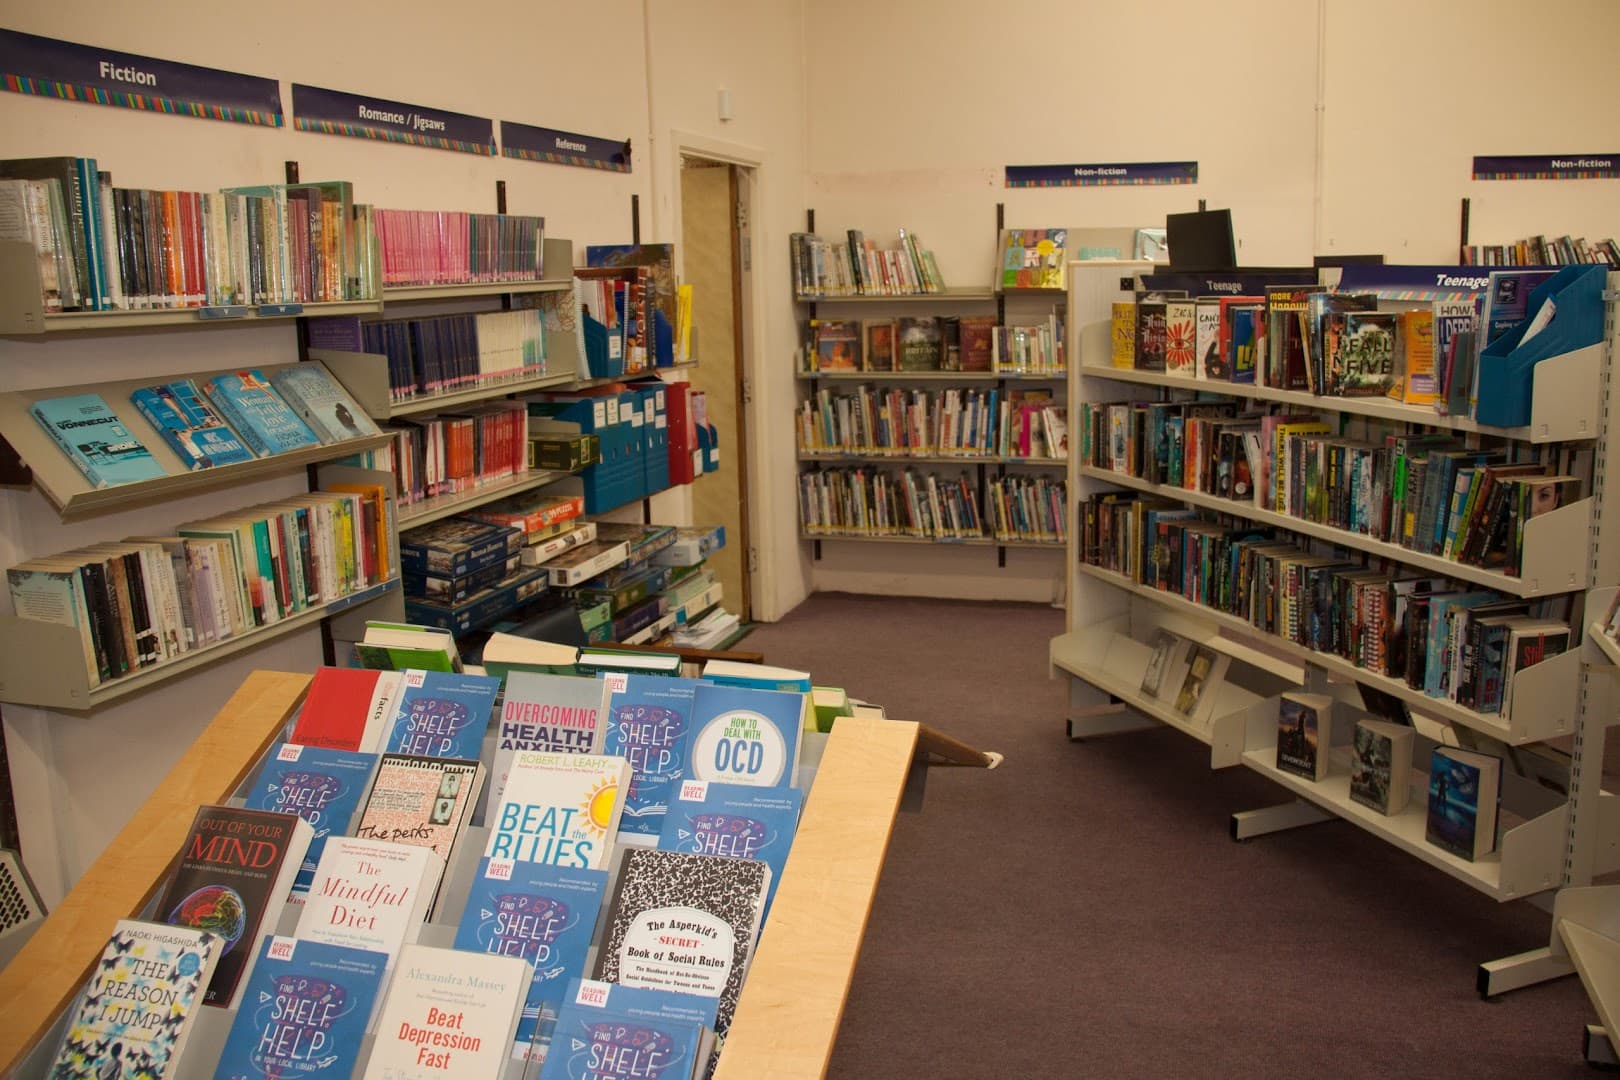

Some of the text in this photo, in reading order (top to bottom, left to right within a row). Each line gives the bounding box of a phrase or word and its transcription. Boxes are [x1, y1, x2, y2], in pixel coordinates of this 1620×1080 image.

[99, 61, 157, 86] Fiction
[359, 105, 405, 125] Romance
[413, 114, 446, 131] Jigsaws
[556, 138, 587, 152] Reference
[1074, 167, 1127, 176] Non-fiction
[1552, 160, 1611, 168] Non-fiction
[1206, 280, 1242, 294] Teenage
[1436, 274, 1489, 289] Teenage
[1349, 339, 1391, 353] FALL
[1346, 360, 1392, 375] FIVE
[374, 697, 389, 720] facts
[505, 701, 597, 729] OVERCOMING
[408, 712, 460, 735] SHELF
[731, 717, 757, 729] HOW TO
[502, 723, 593, 746] HEALTH
[618, 722, 675, 746] SHELF
[724, 728, 761, 740] DEAL WITH
[281, 752, 297, 760] WELL
[519, 754, 560, 765] ROBERT
[573, 759, 608, 768] LEAHY
[714, 738, 764, 775] OCD
[276, 786, 331, 808] SHELF
[683, 790, 703, 799] WELL
[200, 819, 282, 838] OUT OF YOUR
[499, 802, 579, 837] BEAT
[697, 822, 711, 830] FIND
[360, 823, 434, 841] The perks
[572, 829, 587, 839] the
[187, 833, 277, 868] MIND
[492, 832, 593, 869] BLUES
[692, 832, 757, 858] SHELF
[358, 861, 382, 875] The
[489, 868, 509, 877] WELL
[318, 877, 409, 909] Mindful
[500, 902, 515, 910] FIND
[330, 905, 377, 930] Diet
[494, 913, 558, 941] SHELF
[126, 929, 198, 948] NAOKI HIGASHIDA
[646, 919, 719, 939] The Asperkid's
[271, 947, 290, 957] WELL
[658, 935, 700, 949] SECRET
[627, 946, 725, 969] Book of Social Rules
[130, 959, 169, 980] THE
[626, 973, 640, 981] Social
[646, 967, 668, 976] Handbook
[280, 983, 294, 994] FIND
[406, 967, 507, 993] Alexandra Massey
[103, 979, 179, 1006] REASON
[581, 993, 603, 1003] WELL
[98, 1005, 162, 1030] I JUMP
[271, 995, 337, 1027] SHELF
[427, 1008, 463, 1029] Beat
[258, 1022, 326, 1061] HELP
[398, 1023, 481, 1052] Depression
[594, 1031, 611, 1041] FIND
[417, 1048, 451, 1070] Fast
[587, 1043, 662, 1077] SHELF
